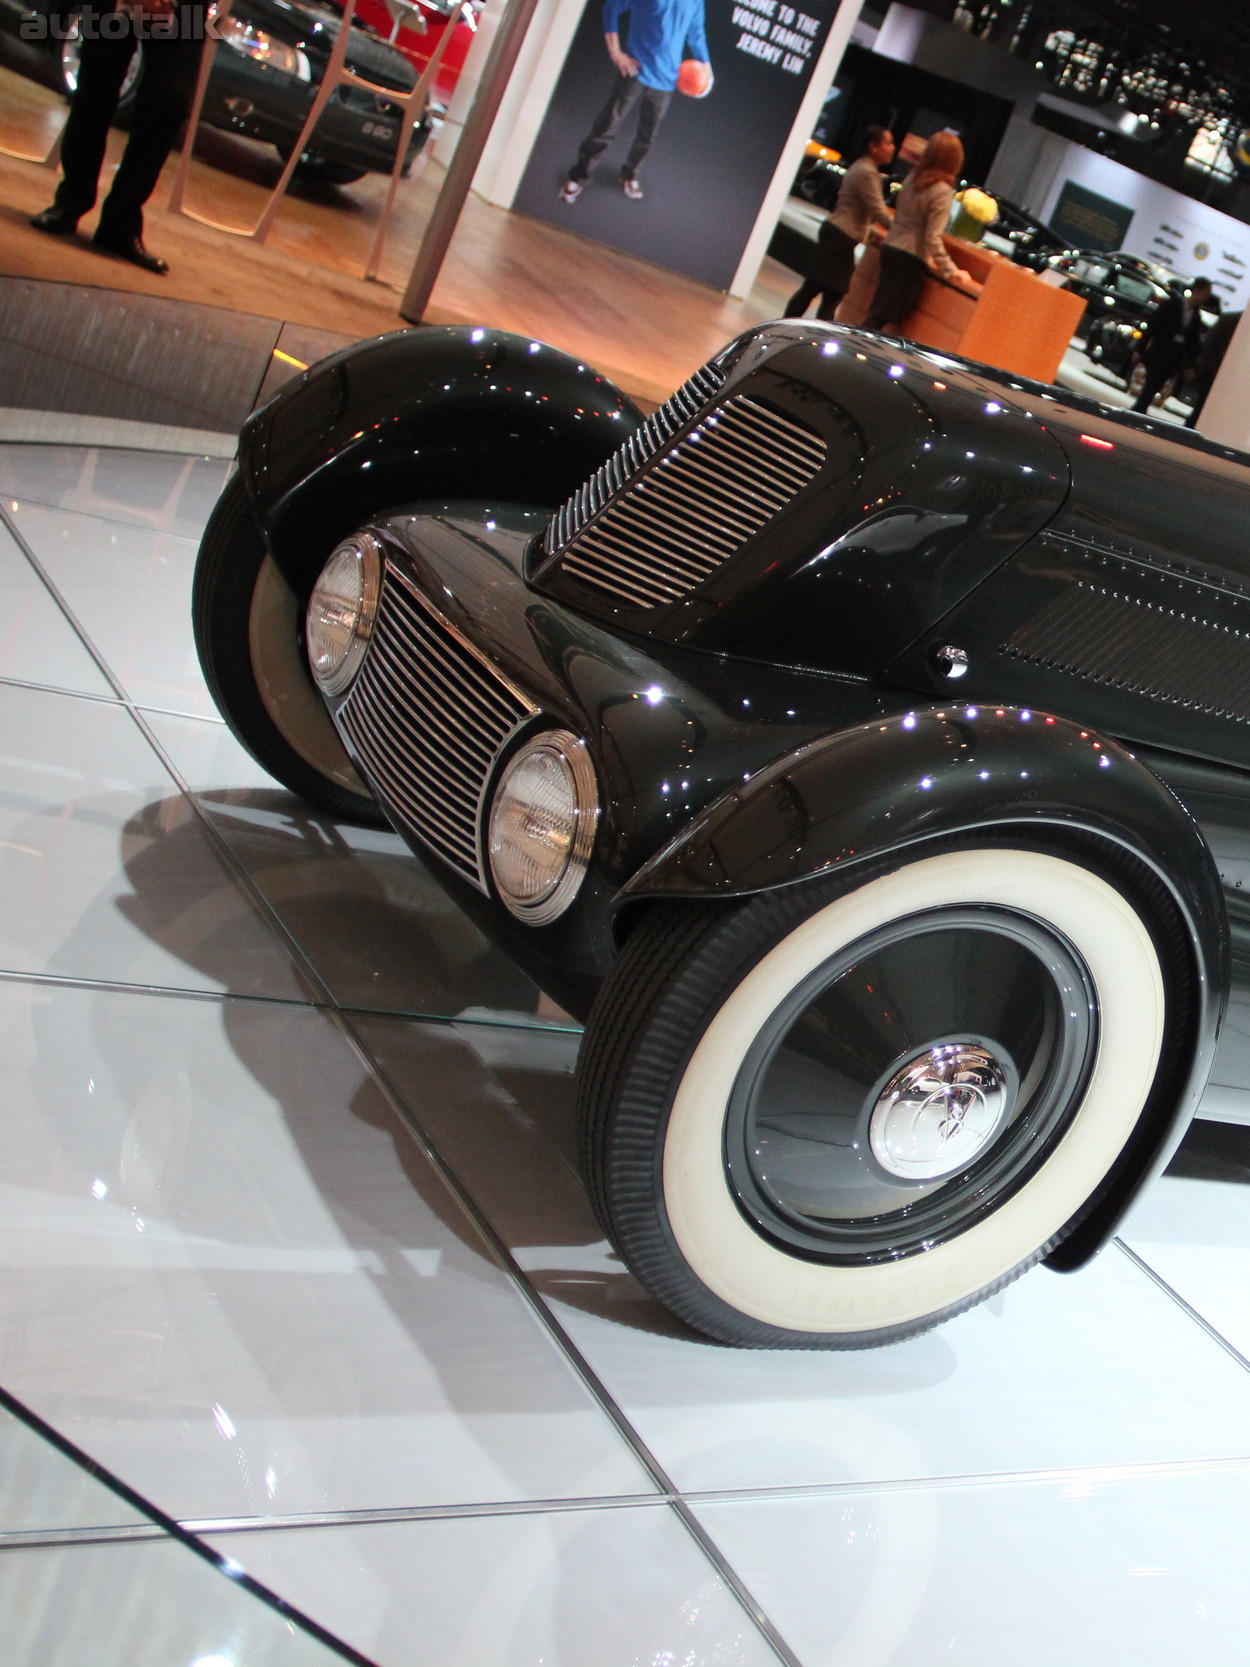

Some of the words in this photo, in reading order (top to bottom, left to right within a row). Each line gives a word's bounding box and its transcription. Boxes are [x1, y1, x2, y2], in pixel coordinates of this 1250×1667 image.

[731, 6, 771, 36] VOLVO
[769, 24, 813, 58] FAMILY,
[777, 4, 796, 25] TO
[795, 12, 821, 37] THE
[735, 32, 783, 64] JEREMY
[781, 52, 805, 75] LIN
